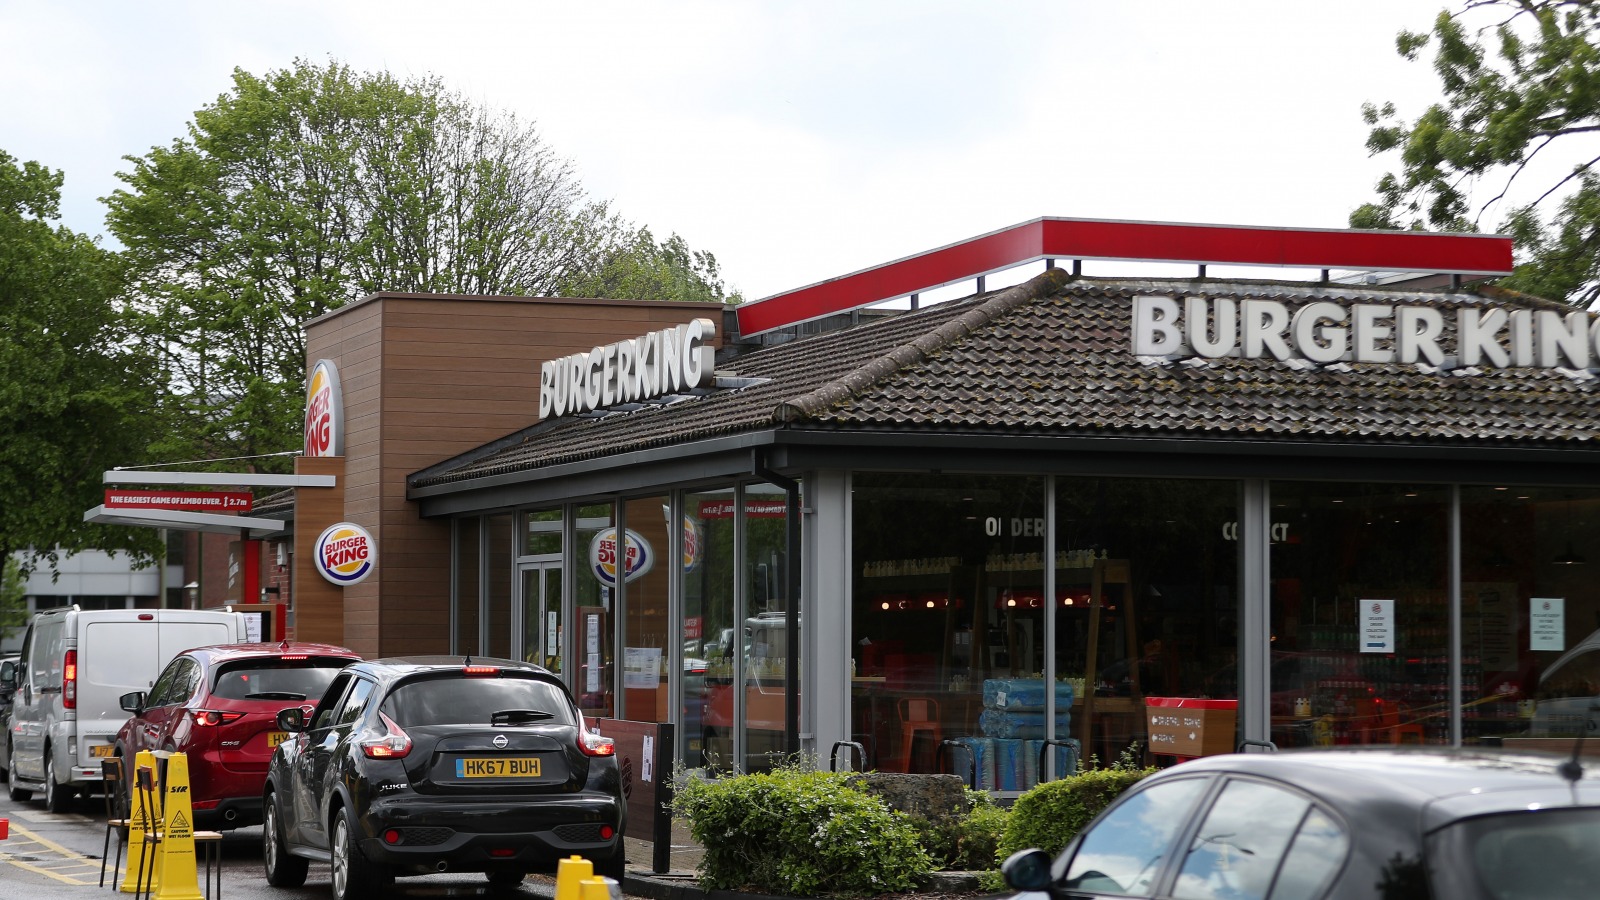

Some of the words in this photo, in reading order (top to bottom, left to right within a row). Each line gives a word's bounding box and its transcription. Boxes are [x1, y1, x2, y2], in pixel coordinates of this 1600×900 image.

[1456, 306, 1600, 368] KIN
[123, 496, 151, 504] EASIEST
[985, 517, 1045, 537] ODER
[1222, 522, 1290, 541] COCT
[325, 536, 366, 555] BURGER
[326, 545, 368, 569] KING
[273, 734, 290, 745] HY
[466, 760, 506, 775] HK67
[509, 760, 539, 774] BUH
[379, 783, 408, 792] JUKE
